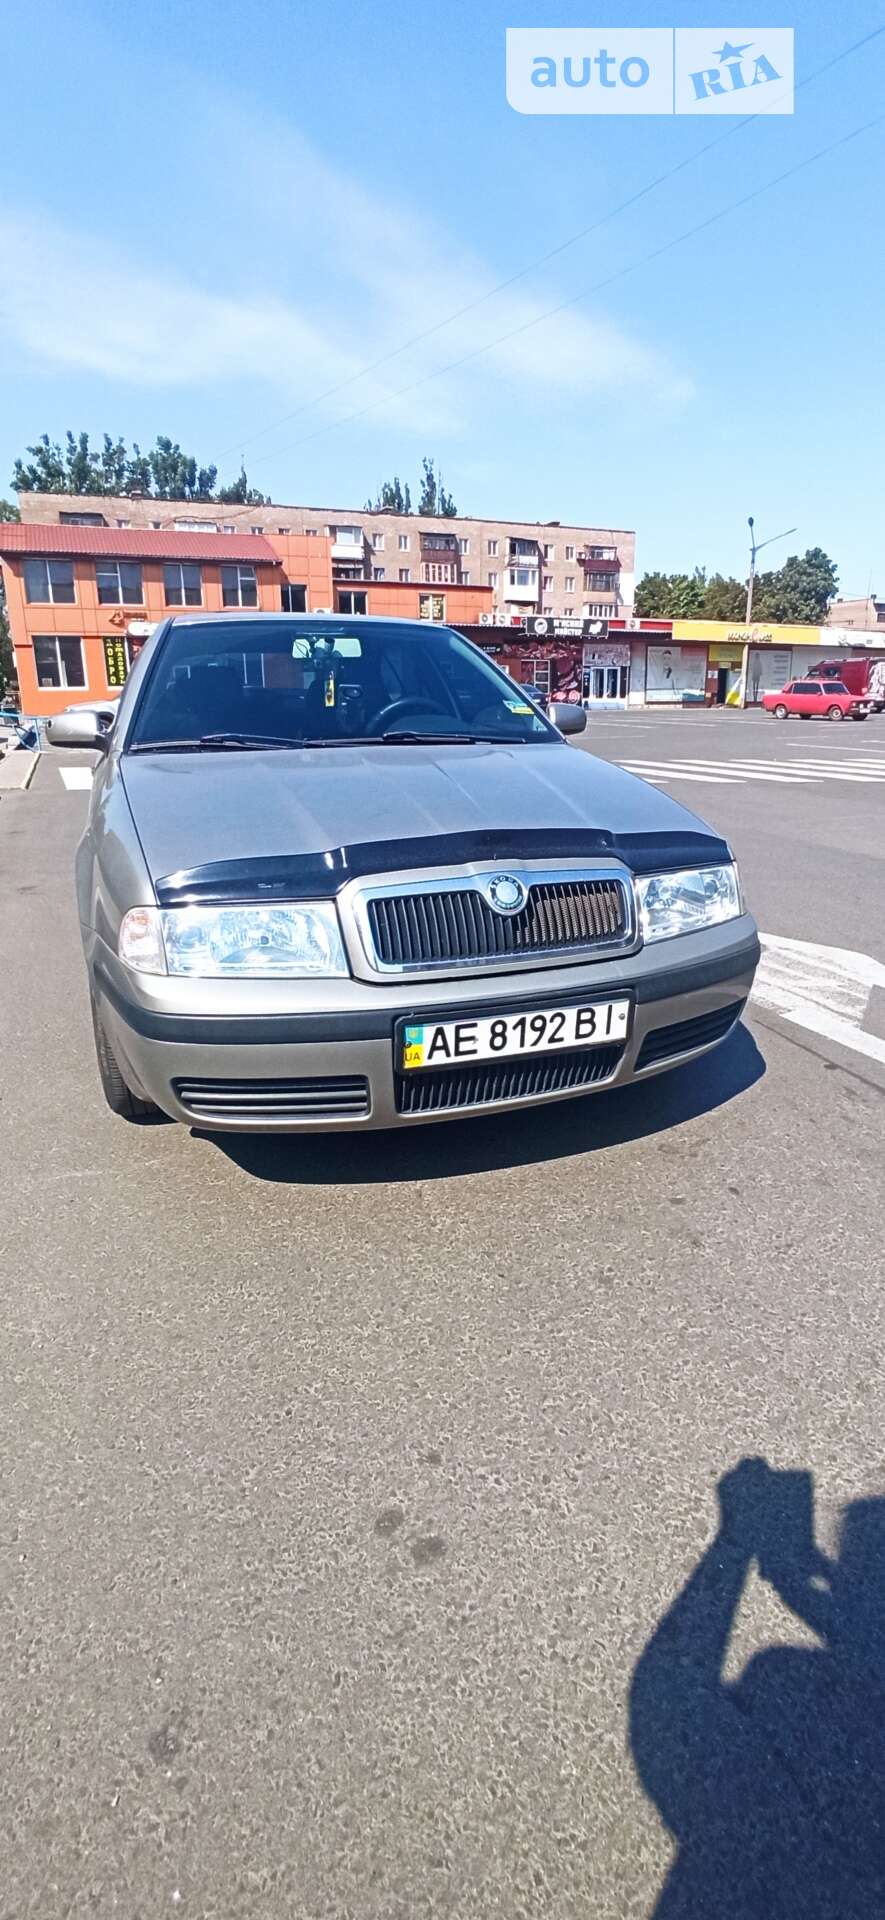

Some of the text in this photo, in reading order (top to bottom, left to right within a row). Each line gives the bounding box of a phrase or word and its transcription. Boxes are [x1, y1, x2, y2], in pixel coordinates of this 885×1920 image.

[106, 638, 116, 684] ДОБРО
[405, 1052, 420, 1062] UA
[427, 1022, 478, 1060] AE
[489, 1012, 567, 1052] 8192
